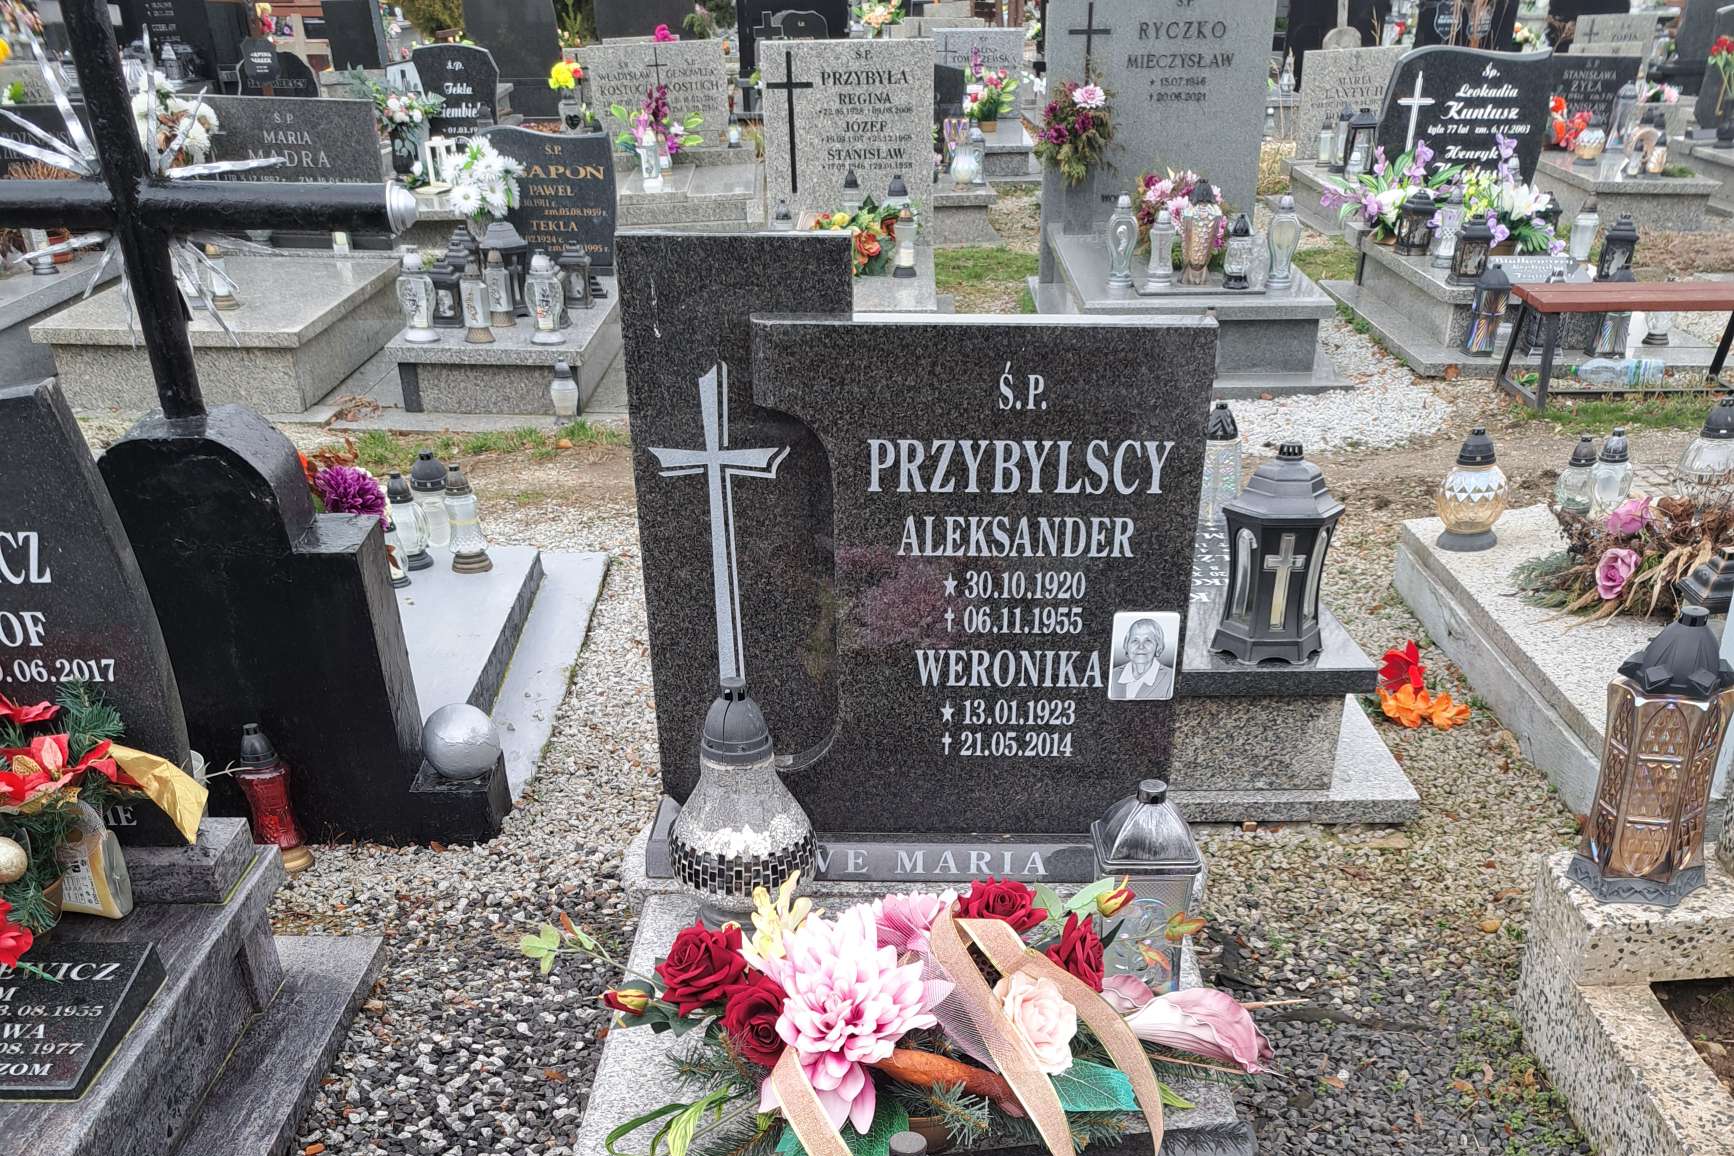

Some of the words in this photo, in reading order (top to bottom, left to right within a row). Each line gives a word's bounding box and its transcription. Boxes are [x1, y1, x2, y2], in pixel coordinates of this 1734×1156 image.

[1138, 20, 1227, 40] RYCZKO
[1126, 52, 1235, 69] MIECZYSŁAW
[838, 93, 893, 105] REGINA
[1455, 83, 1519, 98] Leokadia
[263, 130, 312, 145] MARIA
[844, 119, 888, 133] JÓZEF
[827, 148, 906, 161] STANISŁAW
[1444, 145, 1499, 161] Henryk
[531, 220, 578, 232] TEKLA
[999, 361, 1047, 410] Ś.P.
[866, 438, 1176, 496] PRZYBYLSCY
[898, 515, 1136, 558] ALEKSANDER
[964, 570, 1087, 600] 30.10.1920
[963, 606, 1083, 634] 06.11.1955
[915, 650, 1104, 688] WERONIKA
[962, 699, 1077, 726] 13.01.1923
[959, 731, 1074, 757] 21.05.2014
[816, 849, 870, 873] VE
[894, 850, 1049, 875] MARIA
